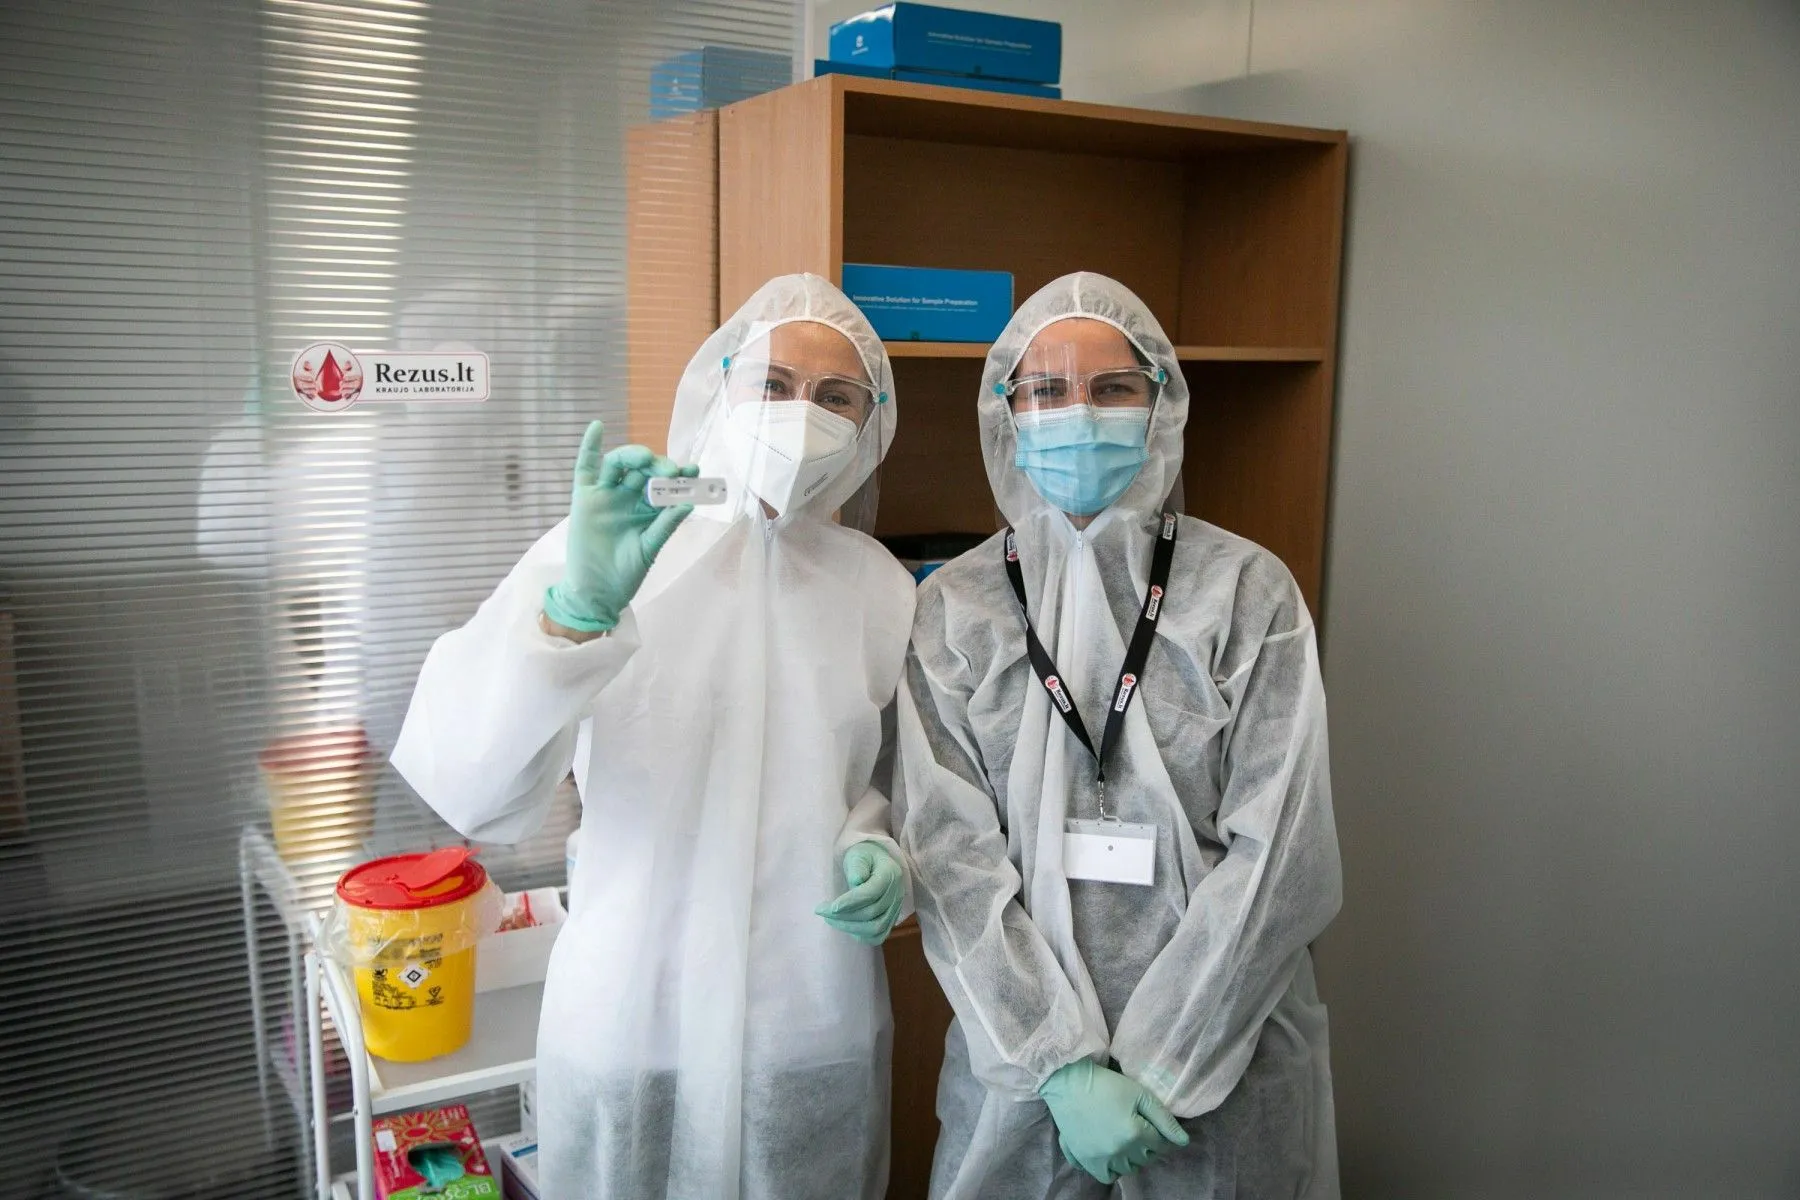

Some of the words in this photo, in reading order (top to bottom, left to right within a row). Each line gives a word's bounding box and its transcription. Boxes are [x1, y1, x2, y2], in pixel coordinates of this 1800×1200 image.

[886, 296, 911, 304] Solution
[922, 297, 944, 305] Sample
[945, 298, 978, 306] Preparation
[375, 362, 475, 383] Rezus.lt
